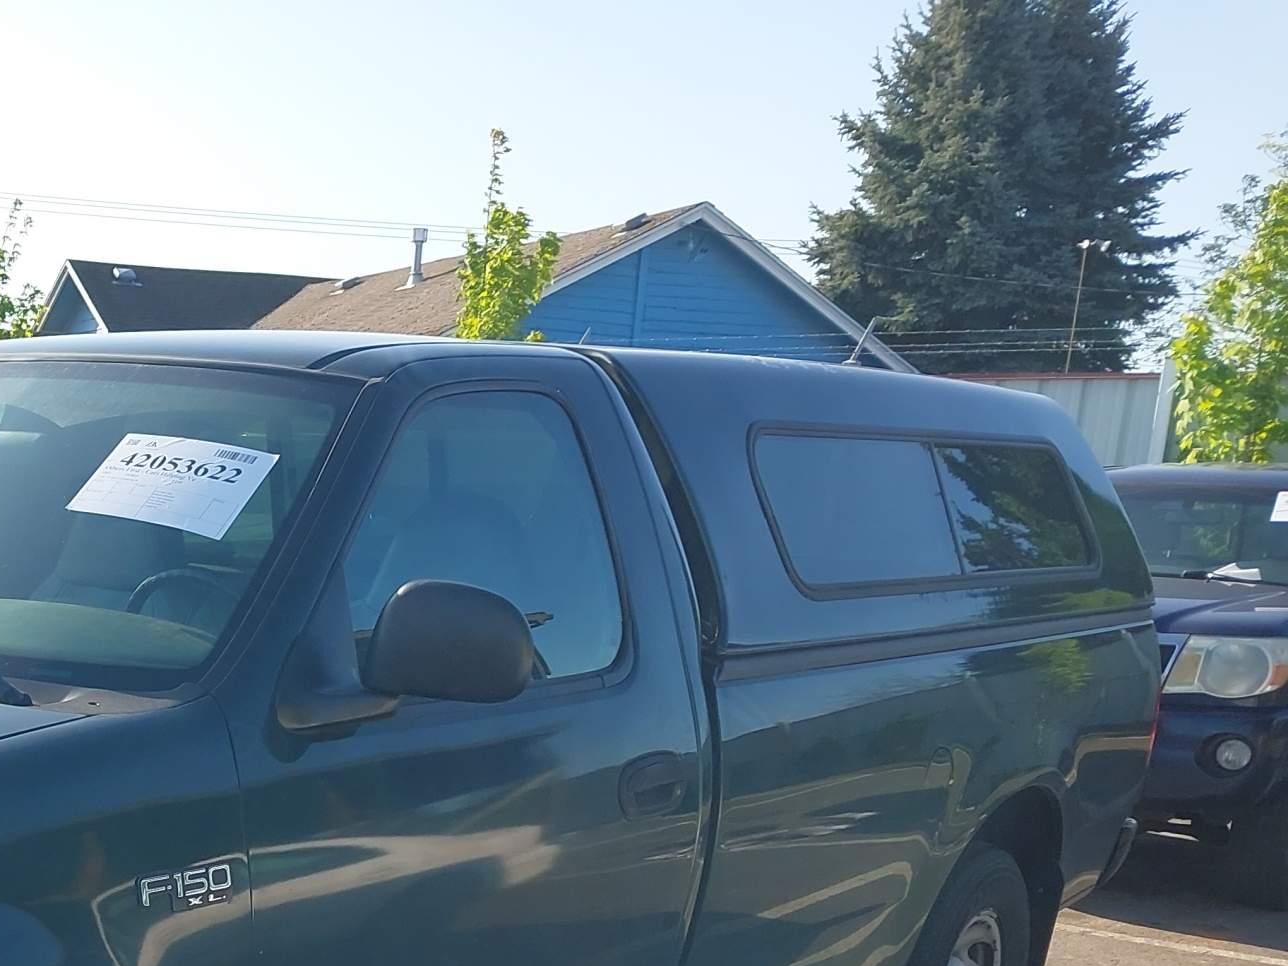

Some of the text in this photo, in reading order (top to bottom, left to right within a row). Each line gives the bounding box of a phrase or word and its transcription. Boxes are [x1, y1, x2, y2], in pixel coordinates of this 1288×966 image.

[120, 452, 244, 484] 42053622
[140, 864, 232, 907] F-150
[188, 893, 227, 906] XL
